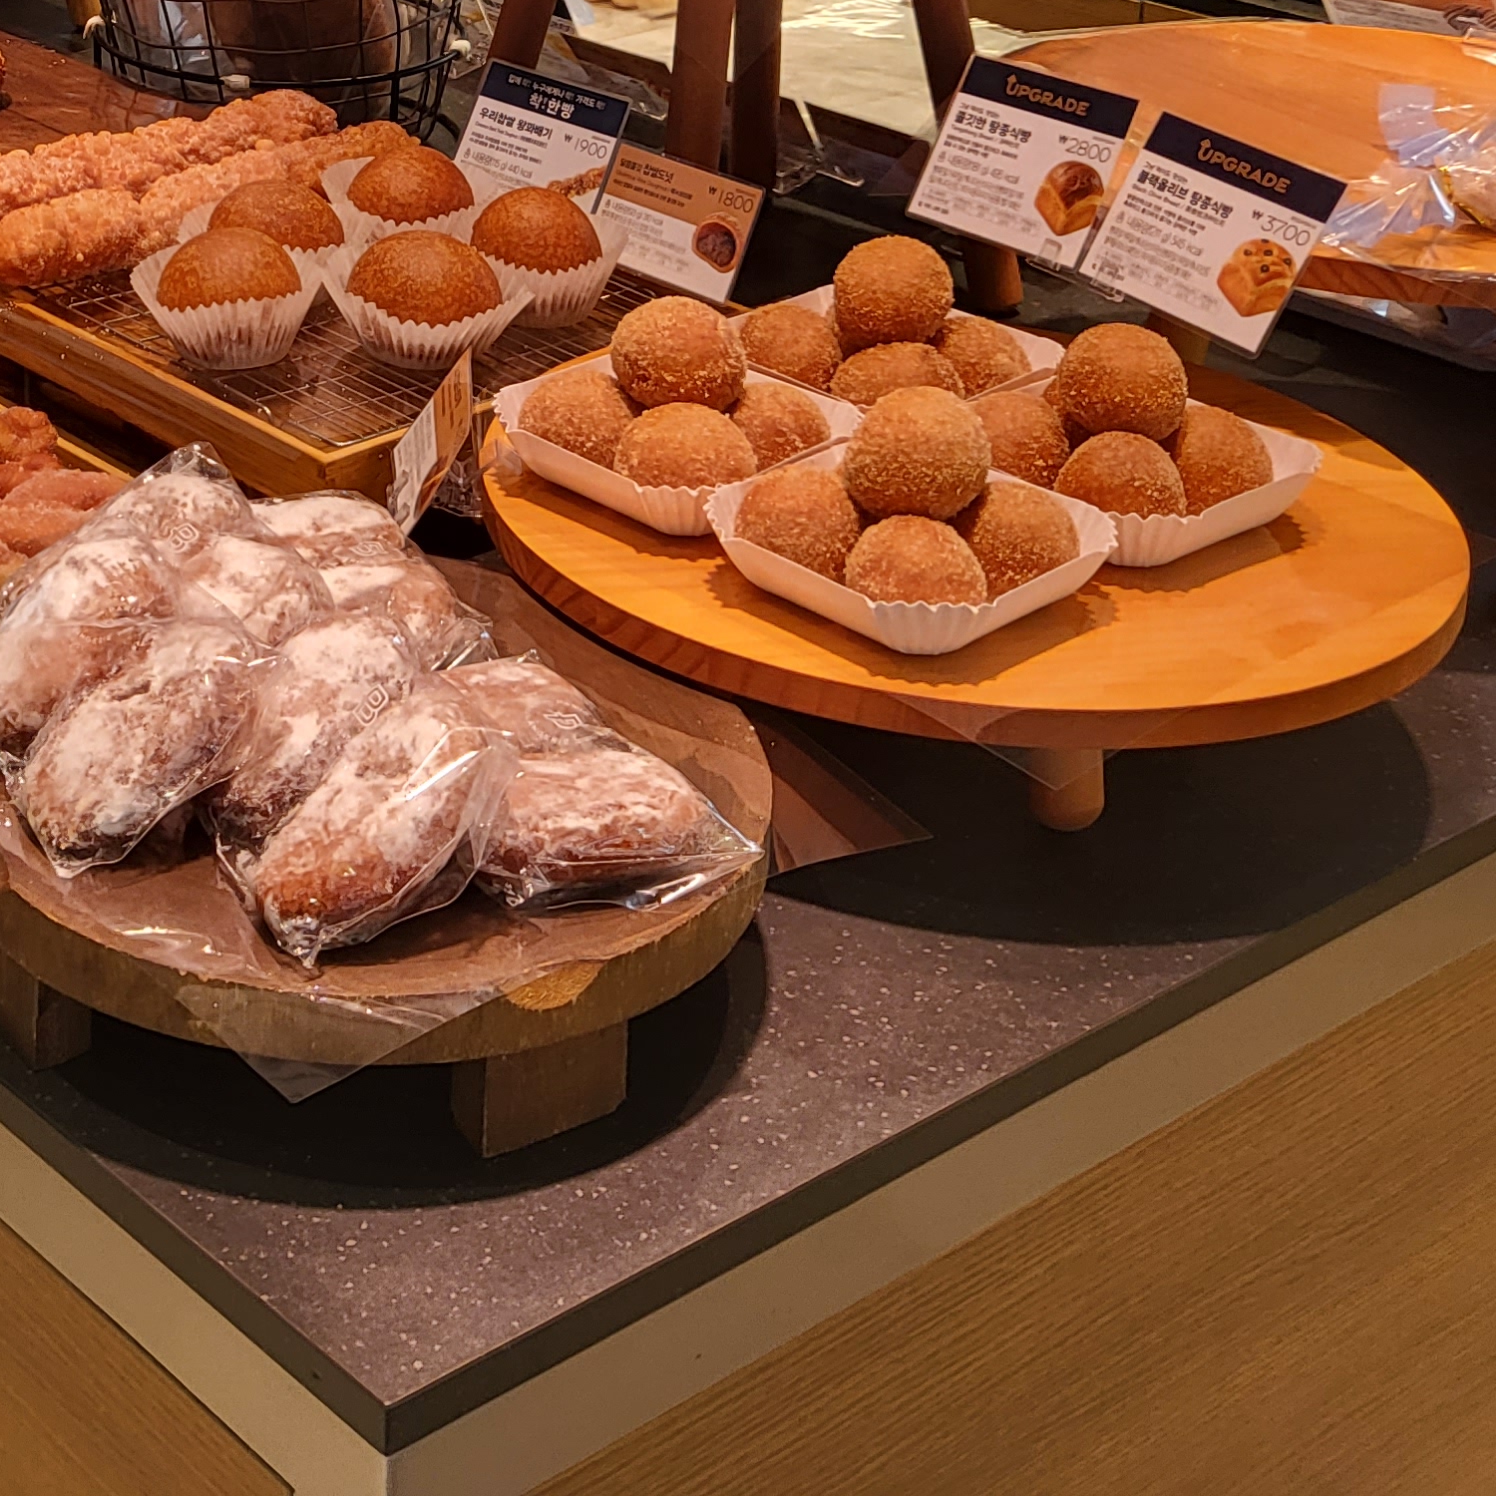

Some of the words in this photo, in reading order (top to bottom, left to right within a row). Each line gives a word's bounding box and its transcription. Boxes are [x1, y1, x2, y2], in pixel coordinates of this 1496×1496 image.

[1006, 74, 1091, 117] UPGRADE
[479, 107, 516, 126] 우리찹쌀
[954, 112, 985, 131] 쫄깃한
[986, 119, 1032, 144] 탕종식빵
[643, 163, 674, 184] 찹쌀도넛
[1197, 139, 1292, 195] UPGRADE
[1137, 169, 1187, 201] 블랙올리브
[1190, 188, 1234, 219] 탕종식빵
